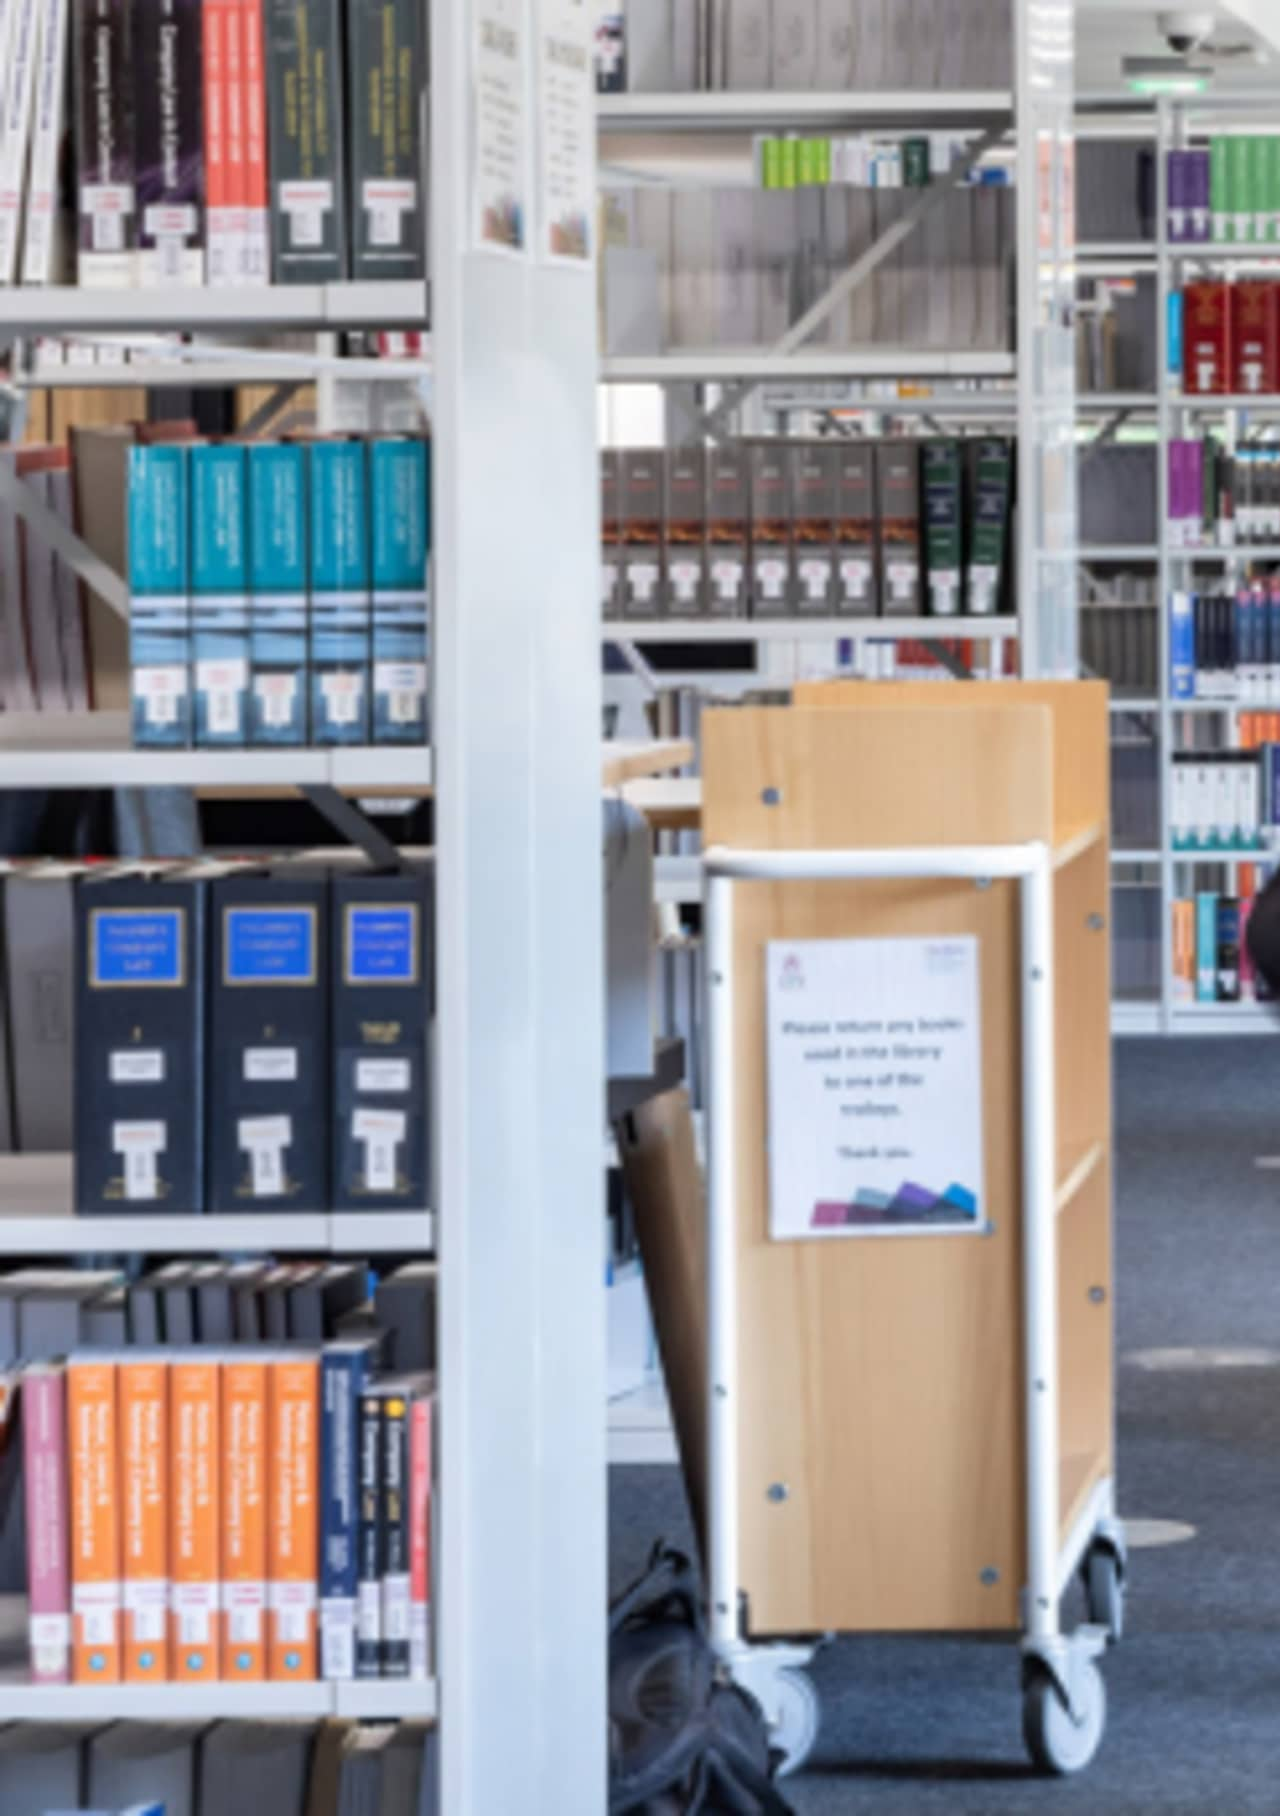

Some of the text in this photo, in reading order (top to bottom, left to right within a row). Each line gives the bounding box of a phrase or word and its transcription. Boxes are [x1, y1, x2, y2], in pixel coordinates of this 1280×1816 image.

[893, 1044, 943, 1061] library
[845, 1075, 873, 1088] one
[877, 1072, 894, 1087] of
[897, 1072, 924, 1086] the
